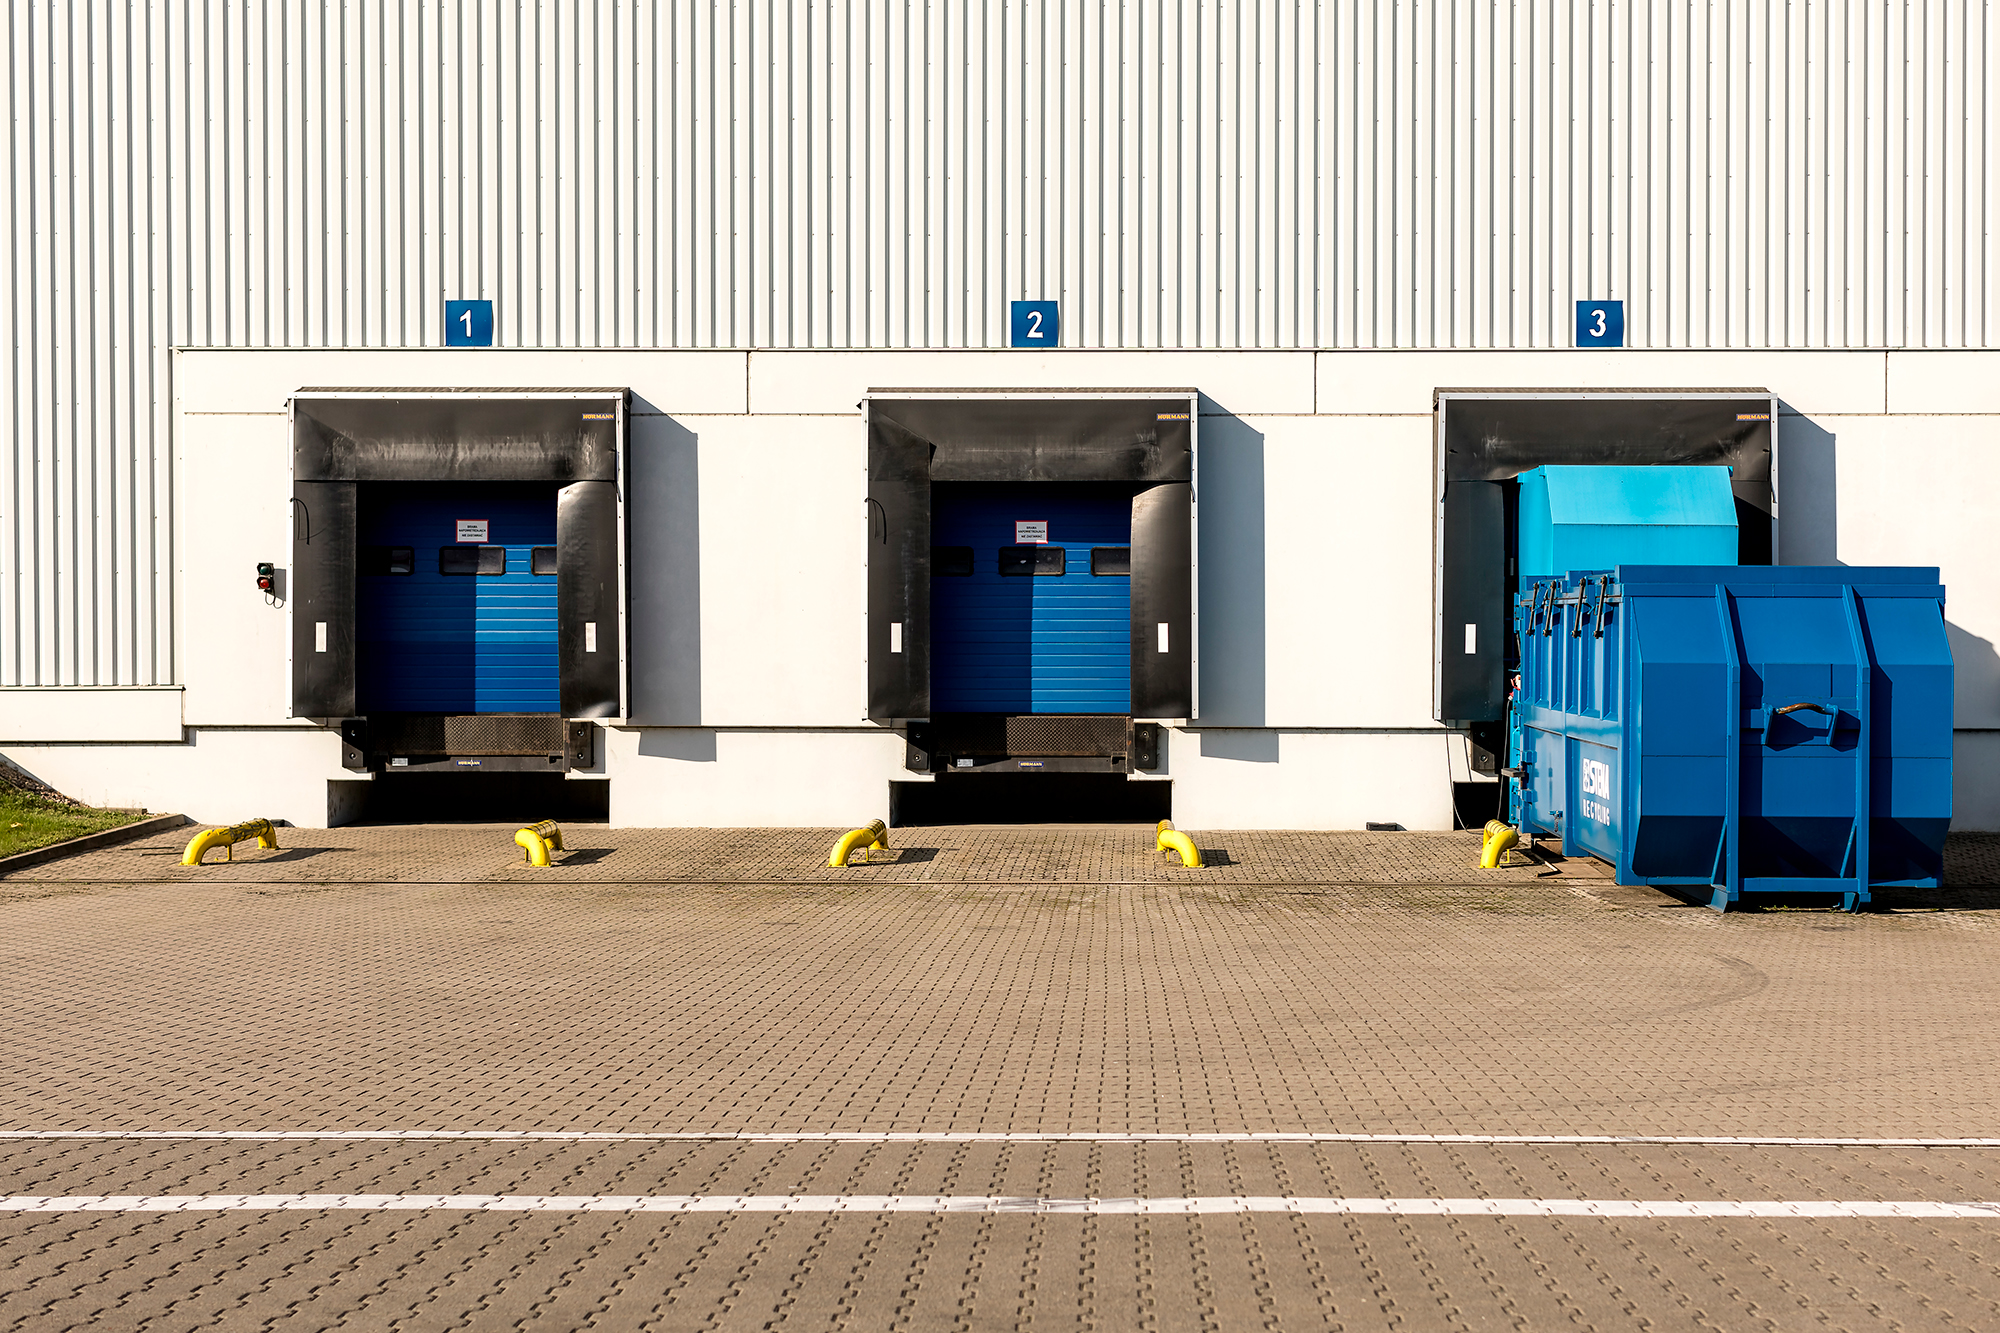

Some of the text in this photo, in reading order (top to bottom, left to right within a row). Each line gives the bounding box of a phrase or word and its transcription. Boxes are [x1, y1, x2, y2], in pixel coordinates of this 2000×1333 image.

[459, 308, 472, 338] 1
[1026, 310, 1044, 338] 2
[1588, 308, 1607, 338] 3
[1582, 798, 1610, 827] RECYCLING
